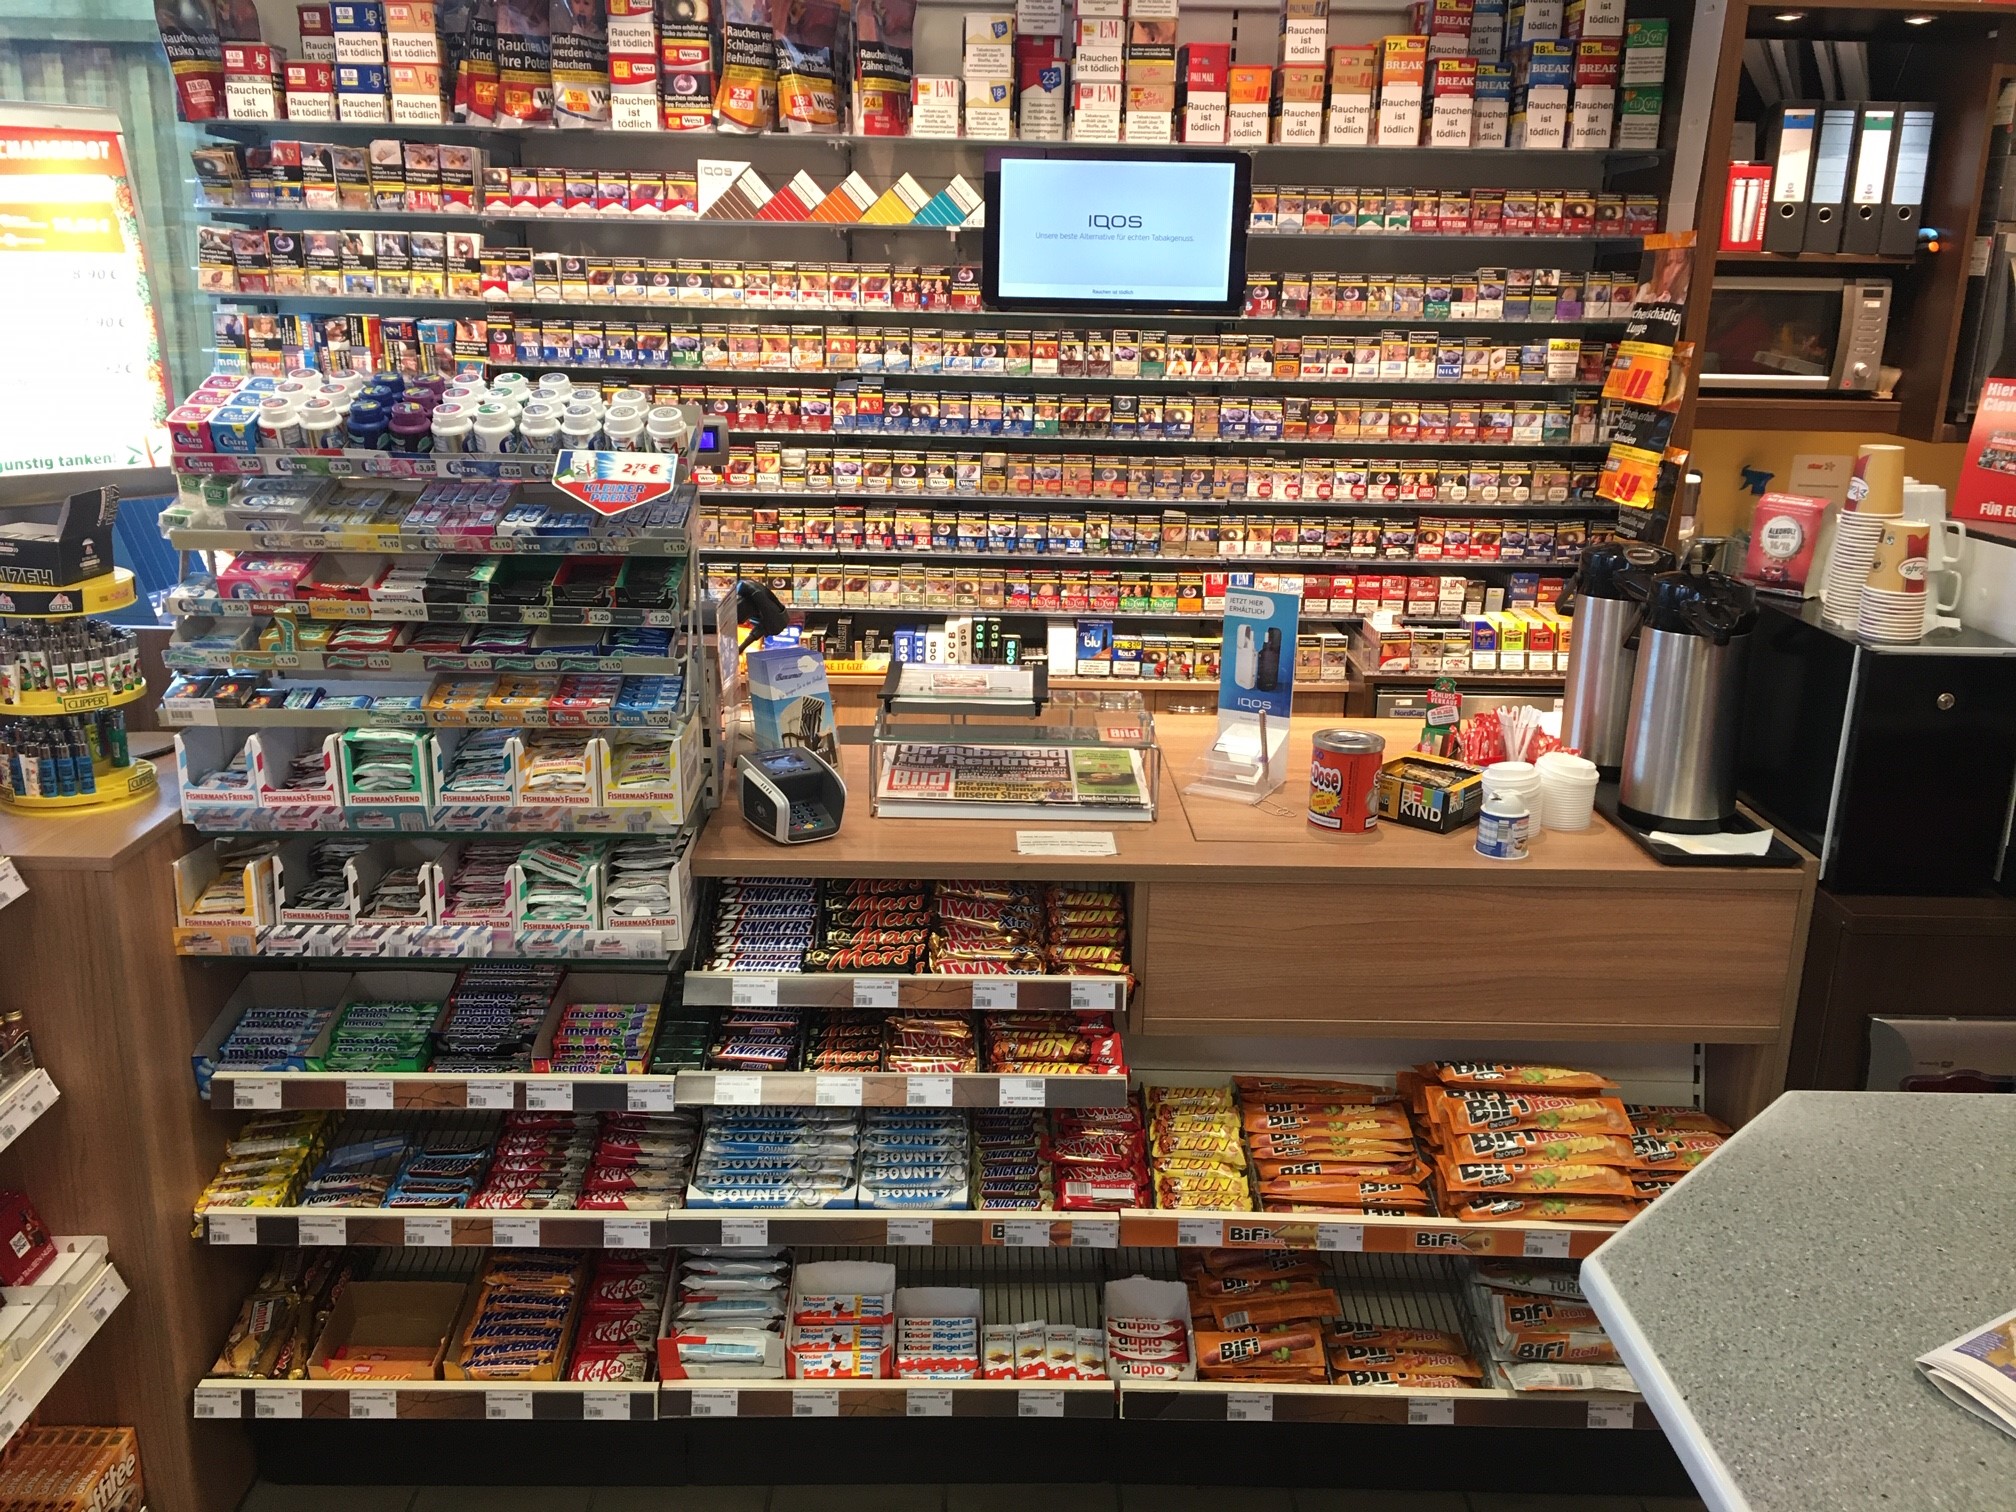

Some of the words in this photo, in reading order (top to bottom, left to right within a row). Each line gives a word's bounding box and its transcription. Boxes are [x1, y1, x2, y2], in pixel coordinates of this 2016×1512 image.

[1435, 15, 1471, 26] BREAK
[611, 28, 650, 38] Rauchen
[338, 37, 379, 48] Rauchen
[392, 38, 433, 48] Rauchen
[610, 39, 623, 48] ist
[625, 38, 654, 49] tödlich
[338, 48, 351, 57] ist
[353, 48, 382, 58] tödlich
[391, 49, 404, 58] ist
[406, 48, 436, 59] tödlich
[680, 50, 702, 60] West
[1080, 54, 1118, 63] Rauchen
[552, 59, 591, 70] Rauchern
[632, 64, 653, 74] West
[1091, 63, 1120, 73] tödlich
[1385, 59, 1424, 70] BREAK
[1532, 63, 1569, 73] BREAK
[1579, 63, 1616, 73] BREAK
[1437, 76, 1474, 87] BREAK
[226, 85, 271, 96] Rauchen
[243, 96, 256, 107] ist
[397, 100, 437, 110] Rauchen
[612, 96, 656, 106] Rauchen
[628, 107, 640, 117] ist
[1187, 102, 1225, 112] Rauchen
[232, 107, 269, 119] tödlich
[395, 110, 407, 119] ist
[410, 110, 440, 120] tödlich
[618, 118, 652, 128] tödlich
[683, 116, 704, 126] West
[1191, 122, 1220, 132] tödlich
[1757, 179, 1770, 241] MEHRWEG-BECHER
[1088, 214, 1142, 230] IQOS
[1035, 232, 1058, 240] Unsere
[1060, 232, 1078, 240] beste
[1079, 233, 1116, 241] Alternative
[1116, 233, 1126, 241] für
[1127, 234, 1150, 242] echten
[1152, 234, 1194, 243] Tabakgenuss.
[504, 466, 520, 475] 3,95
[649, 464, 660, 475] €
[584, 484, 645, 493] KLEINER
[590, 493, 637, 502] PREIS!
[1980, 501, 2002, 516] FÜR
[1230, 597, 1247, 605] JETZT
[1248, 599, 1264, 607] HIER
[1229, 604, 1266, 616] ERHÄLTLICH
[948, 631, 956, 659] OCB
[1084, 636, 1101, 648] blu
[900, 637, 908, 662] OCB
[1006, 640, 1016, 664] OCB
[67, 697, 106, 711] CLIPPER
[1238, 697, 1272, 711] IQOS
[1394, 709, 1425, 717] NordCap
[1110, 729, 1141, 738] Bild
[951, 755, 1066, 767] Rentner!
[892, 770, 949, 786] Bild
[186, 792, 228, 801] FISHERMAN'S
[229, 792, 254, 801] FRIEND
[264, 794, 305, 803] FISHERMAN'S
[306, 794, 332, 803] FRIEND
[351, 795, 393, 803] FISHERMAN'S
[394, 795, 420, 803] FRIEND
[442, 794, 485, 803] FISHERMAN'S
[486, 794, 511, 803] FRIEND
[522, 795, 564, 804] FISHERMAN'S
[565, 795, 590, 804] FRIEND
[607, 792, 648, 801] FISHERMAN'S
[649, 792, 674, 800] FRIEND
[954, 791, 998, 799] unserer
[1000, 791, 1030, 800] Stars
[1400, 801, 1441, 823] KIND
[720, 887, 741, 903] 2
[742, 888, 815, 902] SNICKERS
[1067, 893, 1113, 907] LION
[283, 911, 324, 920] FISHERMAN'S
[325, 912, 350, 920] FRIEND
[723, 903, 743, 919] 2
[746, 904, 818, 918] SNICKERS
[184, 918, 226, 927] FISHERMAN'S
[227, 918, 252, 927] FRIEND
[610, 918, 650, 926] FISHERMAN'S
[651, 918, 676, 927] FRIEND
[739, 920, 813, 936] SNICKERS
[1064, 946, 1115, 961] LION
[827, 948, 910, 971] Mars
[251, 1010, 309, 1019] mentos
[570, 1011, 626, 1019] mentos
[564, 1027, 621, 1036] mentos
[1017, 1036, 1077, 1058] LION
[229, 1048, 288, 1060] mentos
[814, 1050, 880, 1065] Mars
[551, 1064, 596, 1073] mentos
[1467, 1098, 1530, 1125] BiFi
[1179, 1137, 1233, 1152] LION
[877, 1152, 947, 1164] BOUNTY
[875, 1168, 951, 1180] BOUNTY
[984, 1165, 1037, 1178] SNICKERS
[983, 1181, 1036, 1193] SNICKERS
[713, 1189, 798, 1203] BOUNTY
[1230, 1227, 1271, 1241] BiFi
[1416, 1233, 1459, 1247] BiFi
[605, 1279, 645, 1299] KitKat
[932, 1319, 961, 1328] Riegel
[472, 1325, 561, 1339] WUNDERBAR
[600, 1319, 641, 1342] KitKat
[932, 1331, 961, 1341] Riegel
[1415, 1332, 1440, 1342] Hot
[932, 1344, 960, 1353] Riegel
[1220, 1337, 1261, 1361] BiFi
[1518, 1341, 1566, 1359] BiFi
[1570, 1346, 1599, 1358] Roll
[1429, 1356, 1454, 1367] Hot
[579, 1359, 624, 1381] KitKat
[1121, 1362, 1165, 1376] duplo
